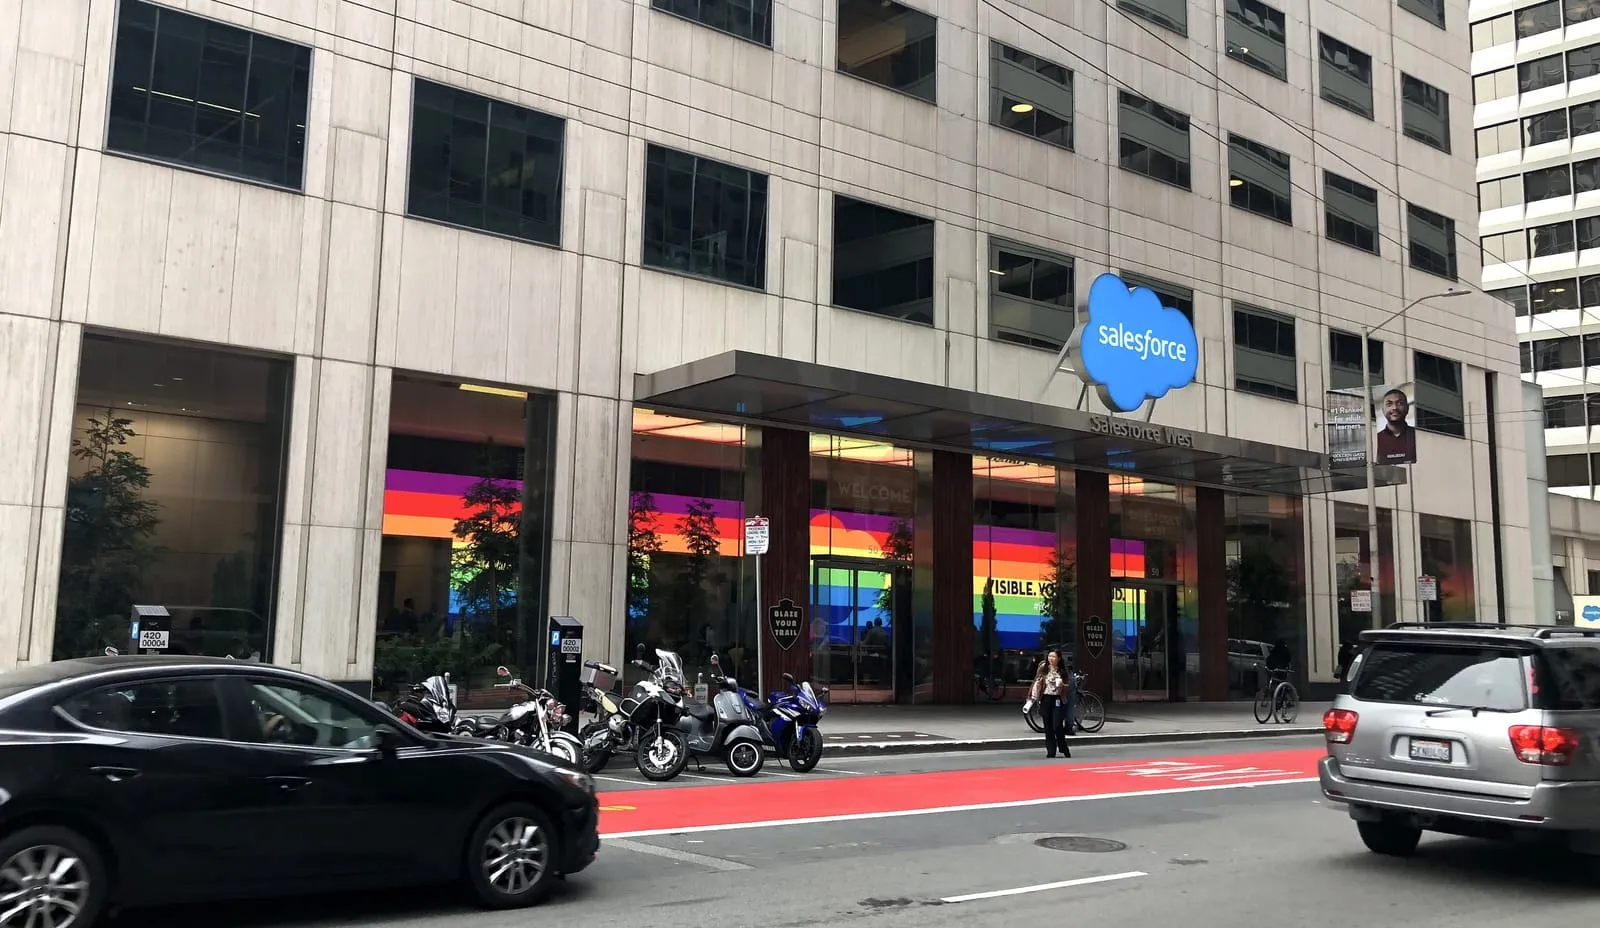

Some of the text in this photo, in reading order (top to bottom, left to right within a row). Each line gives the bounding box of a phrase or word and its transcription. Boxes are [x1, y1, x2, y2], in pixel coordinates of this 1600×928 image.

[1099, 323, 1186, 362] salesforce
[1340, 406, 1363, 414] Ranked
[1091, 416, 1195, 448] Salesforce West
[838, 481, 911, 503] WELCOME
[774, 610, 799, 618] BLAZE
[775, 619, 797, 627] YOUR
[1086, 624, 1104, 632] BLAZE
